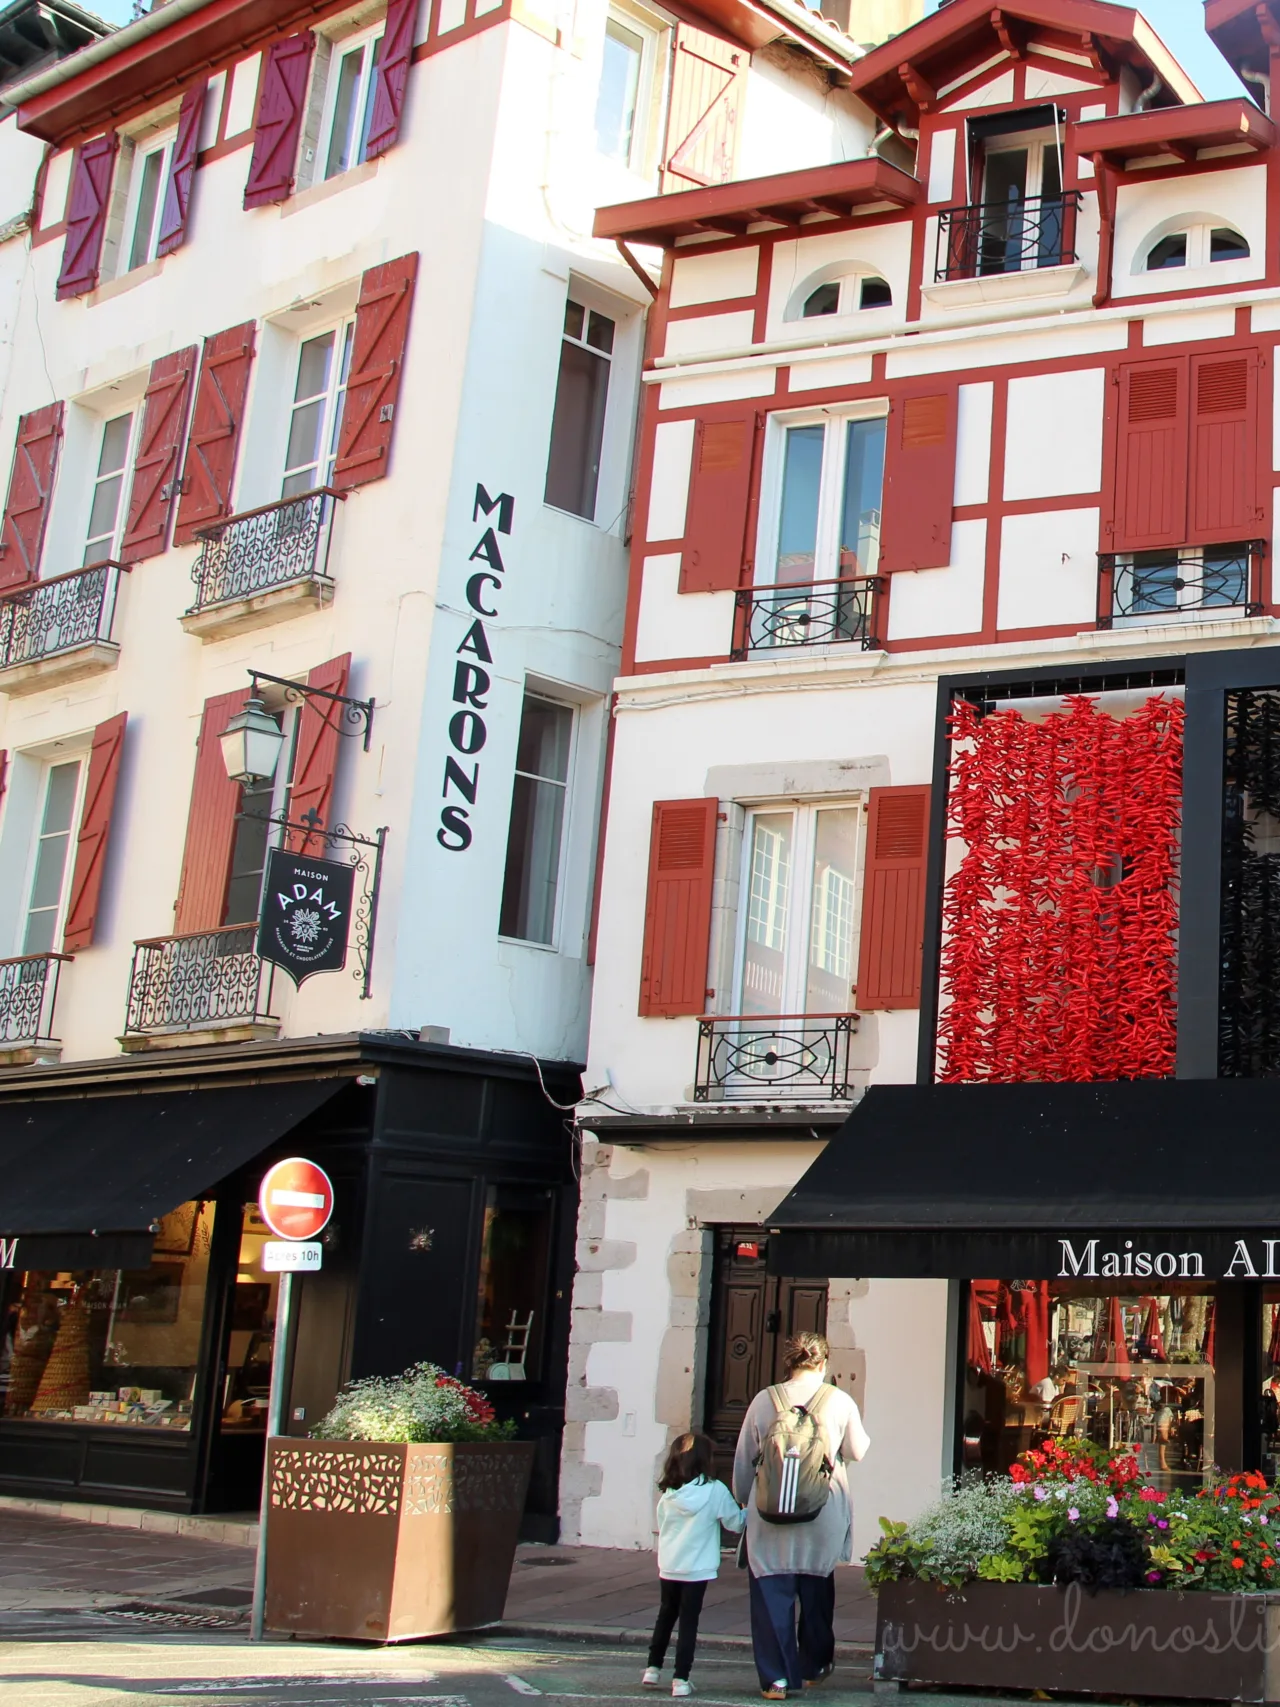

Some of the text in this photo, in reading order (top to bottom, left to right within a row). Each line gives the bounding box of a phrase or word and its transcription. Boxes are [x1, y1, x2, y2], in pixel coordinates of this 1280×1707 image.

[437, 482, 515, 852] MACARONS
[294, 868, 329, 882] MAISON
[278, 883, 342, 921] ADAM
[302, 1250, 319, 1261] 10h
[1057, 1239, 1206, 1277] Maison
[1045, 1340, 1095, 1349] MAISON
